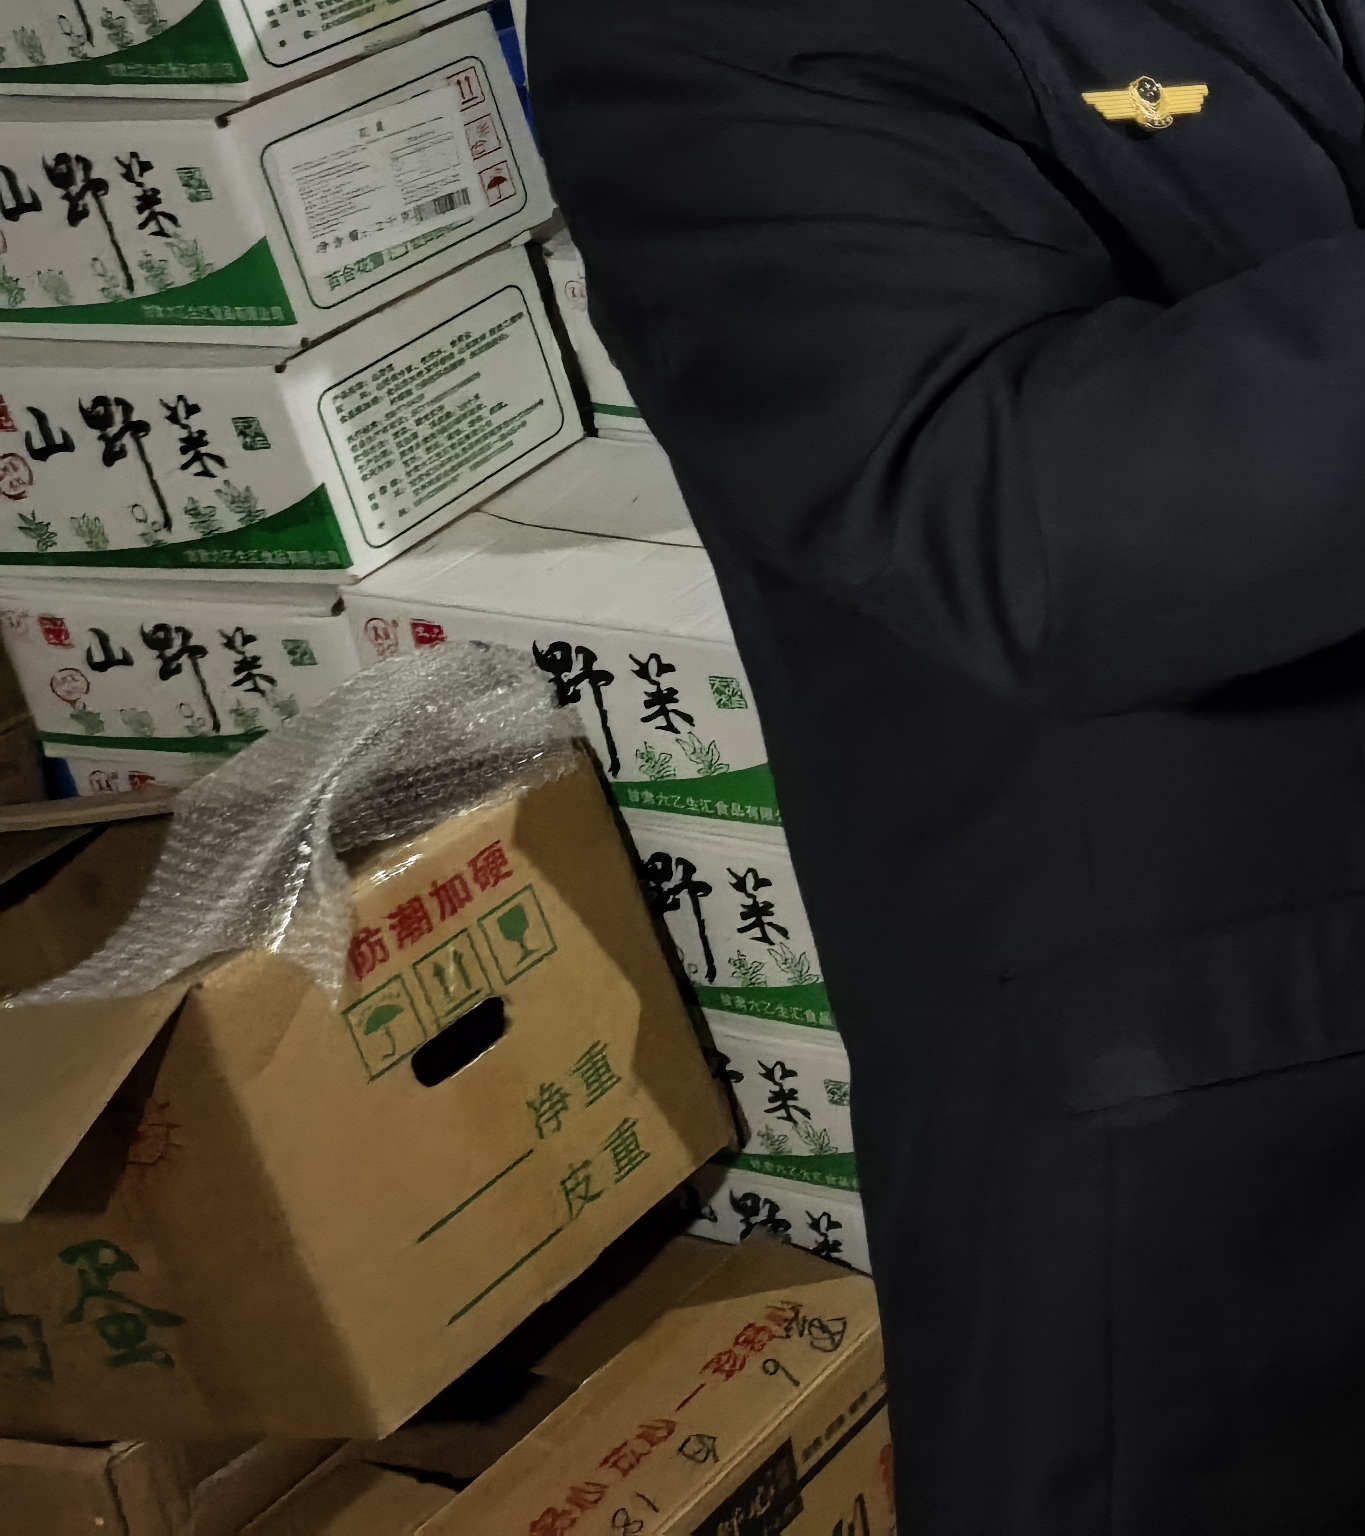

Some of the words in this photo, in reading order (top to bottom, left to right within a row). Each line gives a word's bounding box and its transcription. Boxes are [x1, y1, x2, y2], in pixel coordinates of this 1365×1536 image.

[0, 150, 182, 293] 山野菜
[25, 394, 229, 534] 山野菜
[86, 621, 279, 734] 山野菜
[532, 640, 696, 778] 野菜
[347, 839, 514, 981] 防潮加硬
[526, 1039, 622, 1140] 净重
[560, 1117, 651, 1221] 皮重
